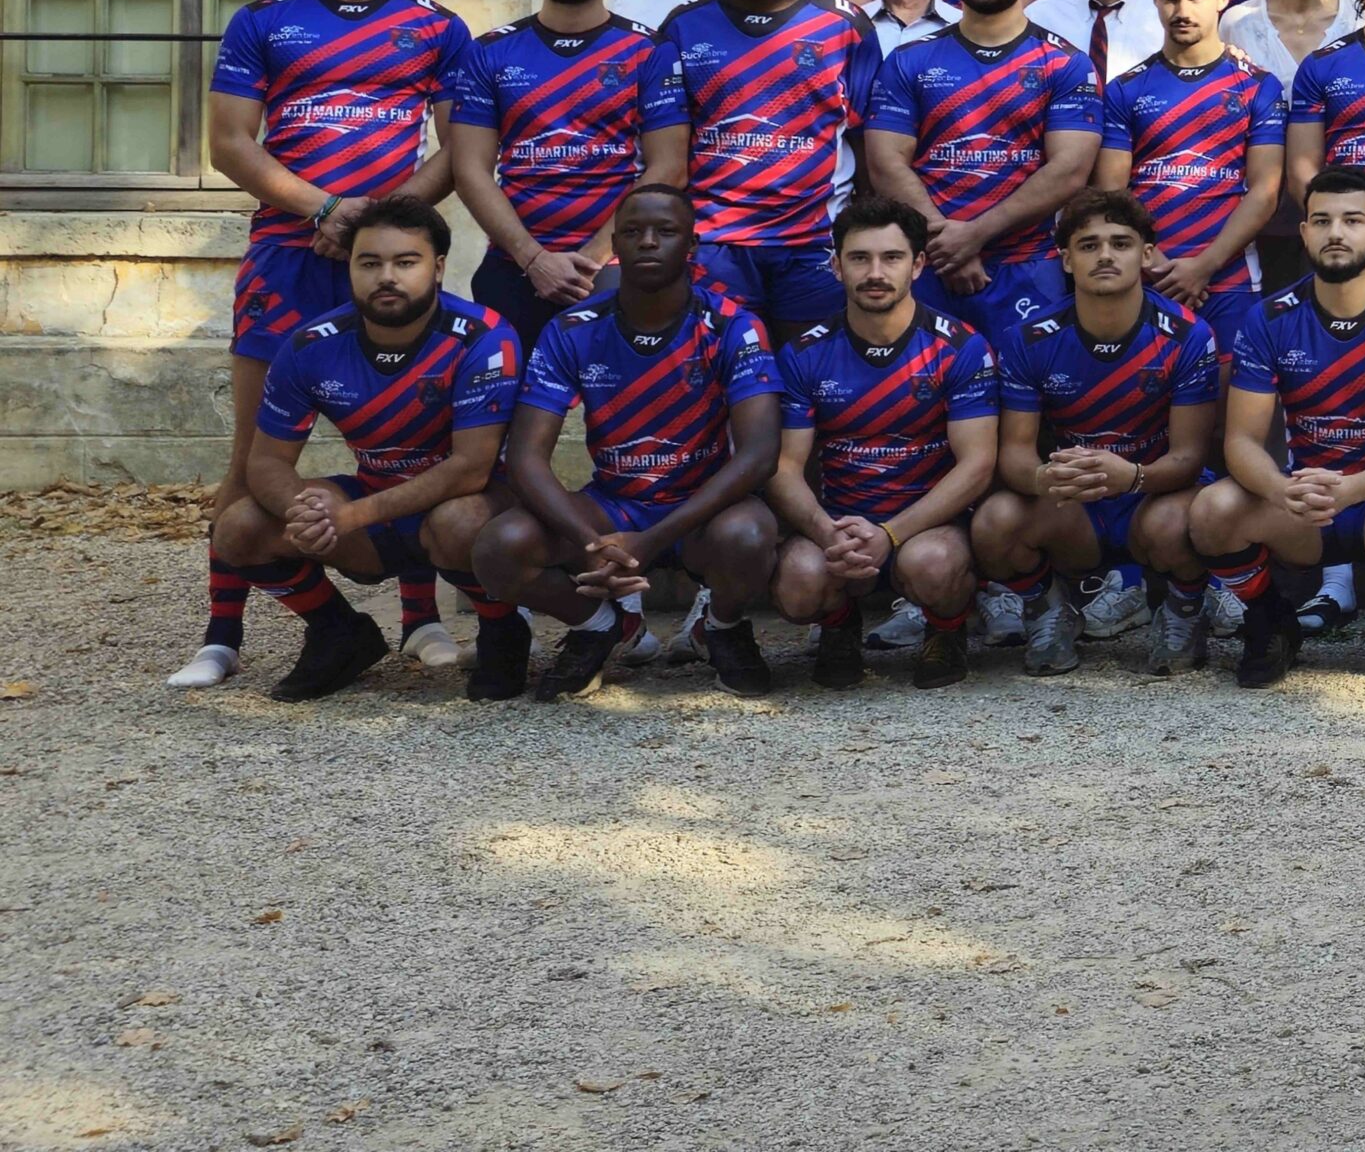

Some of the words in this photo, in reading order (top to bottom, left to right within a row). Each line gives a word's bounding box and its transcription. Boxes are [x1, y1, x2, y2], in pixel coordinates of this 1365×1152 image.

[745, 16, 772, 24] FXV
[313, 106, 373, 121] MARTINS
[378, 108, 386, 118] &
[390, 108, 412, 122] FILS
[722, 133, 775, 150] MARTINS
[777, 135, 786, 148] &
[790, 136, 814, 152] FILS
[536, 145, 588, 160] MARTINS
[592, 145, 600, 155] &
[603, 144, 626, 154] FILS
[957, 150, 1007, 165] MARTINS
[1011, 150, 1018, 161] &
[1021, 150, 1040, 161] FILS
[1161, 165, 1207, 178] MARTINS
[1210, 167, 1216, 177] &
[1220, 168, 1239, 181] FILS
[1330, 321, 1357, 330] FXV
[634, 336, 662, 345] FXV
[866, 348, 893, 356] FXV
[1094, 344, 1120, 352] FXV
[376, 354, 405, 362] FXV
[370, 457, 430, 471] MARTINS
[622, 454, 677, 468] MARTINS
[682, 452, 690, 462] &
